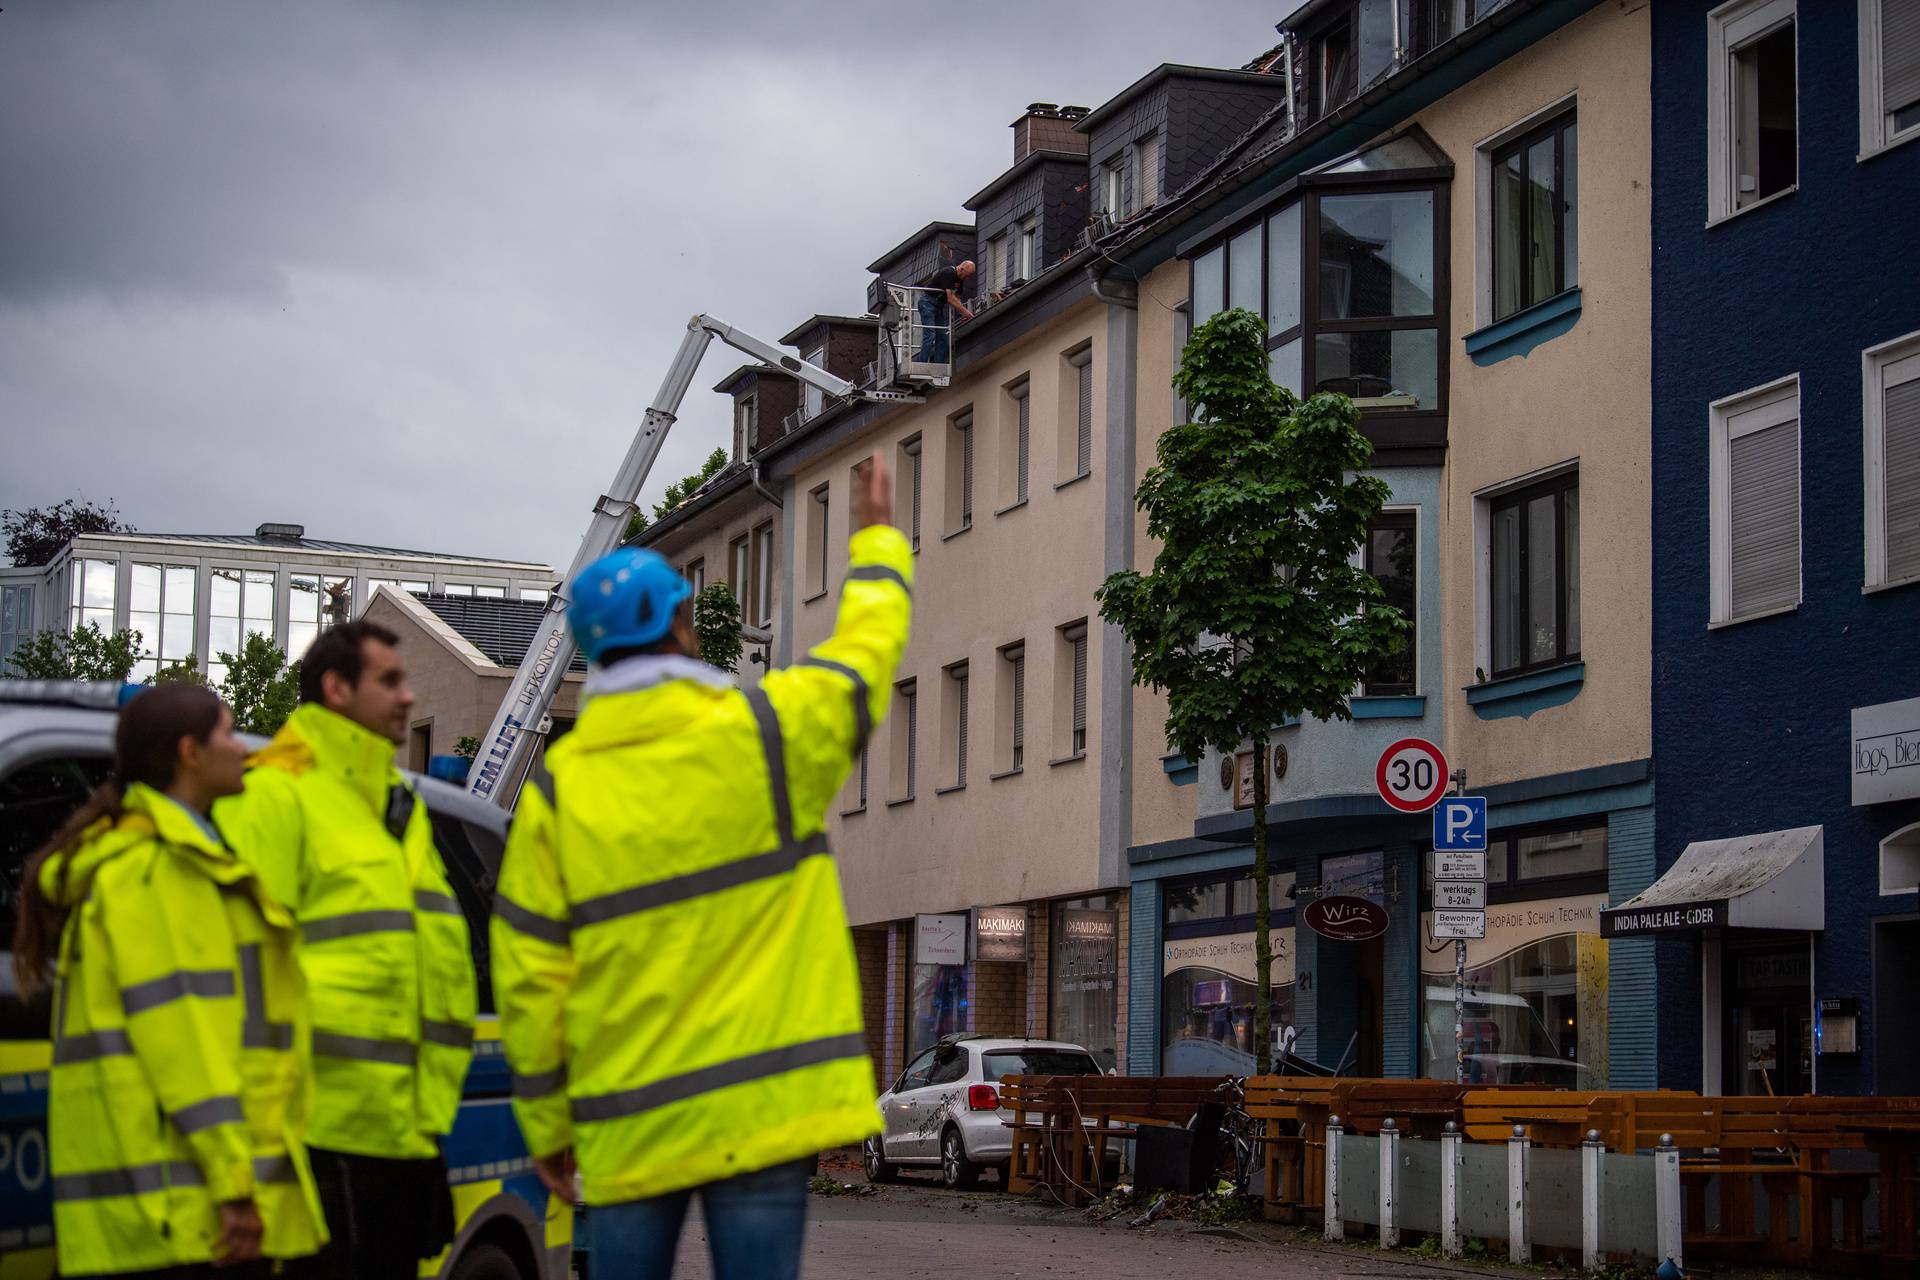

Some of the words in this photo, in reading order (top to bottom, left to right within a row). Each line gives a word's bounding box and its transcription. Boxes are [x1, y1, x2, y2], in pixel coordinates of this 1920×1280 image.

[519, 629, 565, 706] LIFTKONTOR
[472, 760, 503, 799] EM
[490, 713, 522, 761] LIFT
[1391, 759, 1433, 792] 30
[1446, 804, 1473, 844] P
[1443, 885, 1476, 896] werktags
[1448, 896, 1470, 905] 8-24h
[1322, 903, 1369, 920] Wirz
[1439, 913, 1480, 922] Bewohner
[1487, 914, 1523, 929] THOPÄDIE
[1527, 911, 1554, 925] SCHUH
[1559, 906, 1593, 922] TECHNIK
[978, 918, 1025, 931] MAKIMAKI
[1614, 914, 1639, 931] INDIA
[1640, 912, 1662, 929] PALE
[1663, 911, 1680, 927] ALE
[1452, 927, 1467, 935] frei
